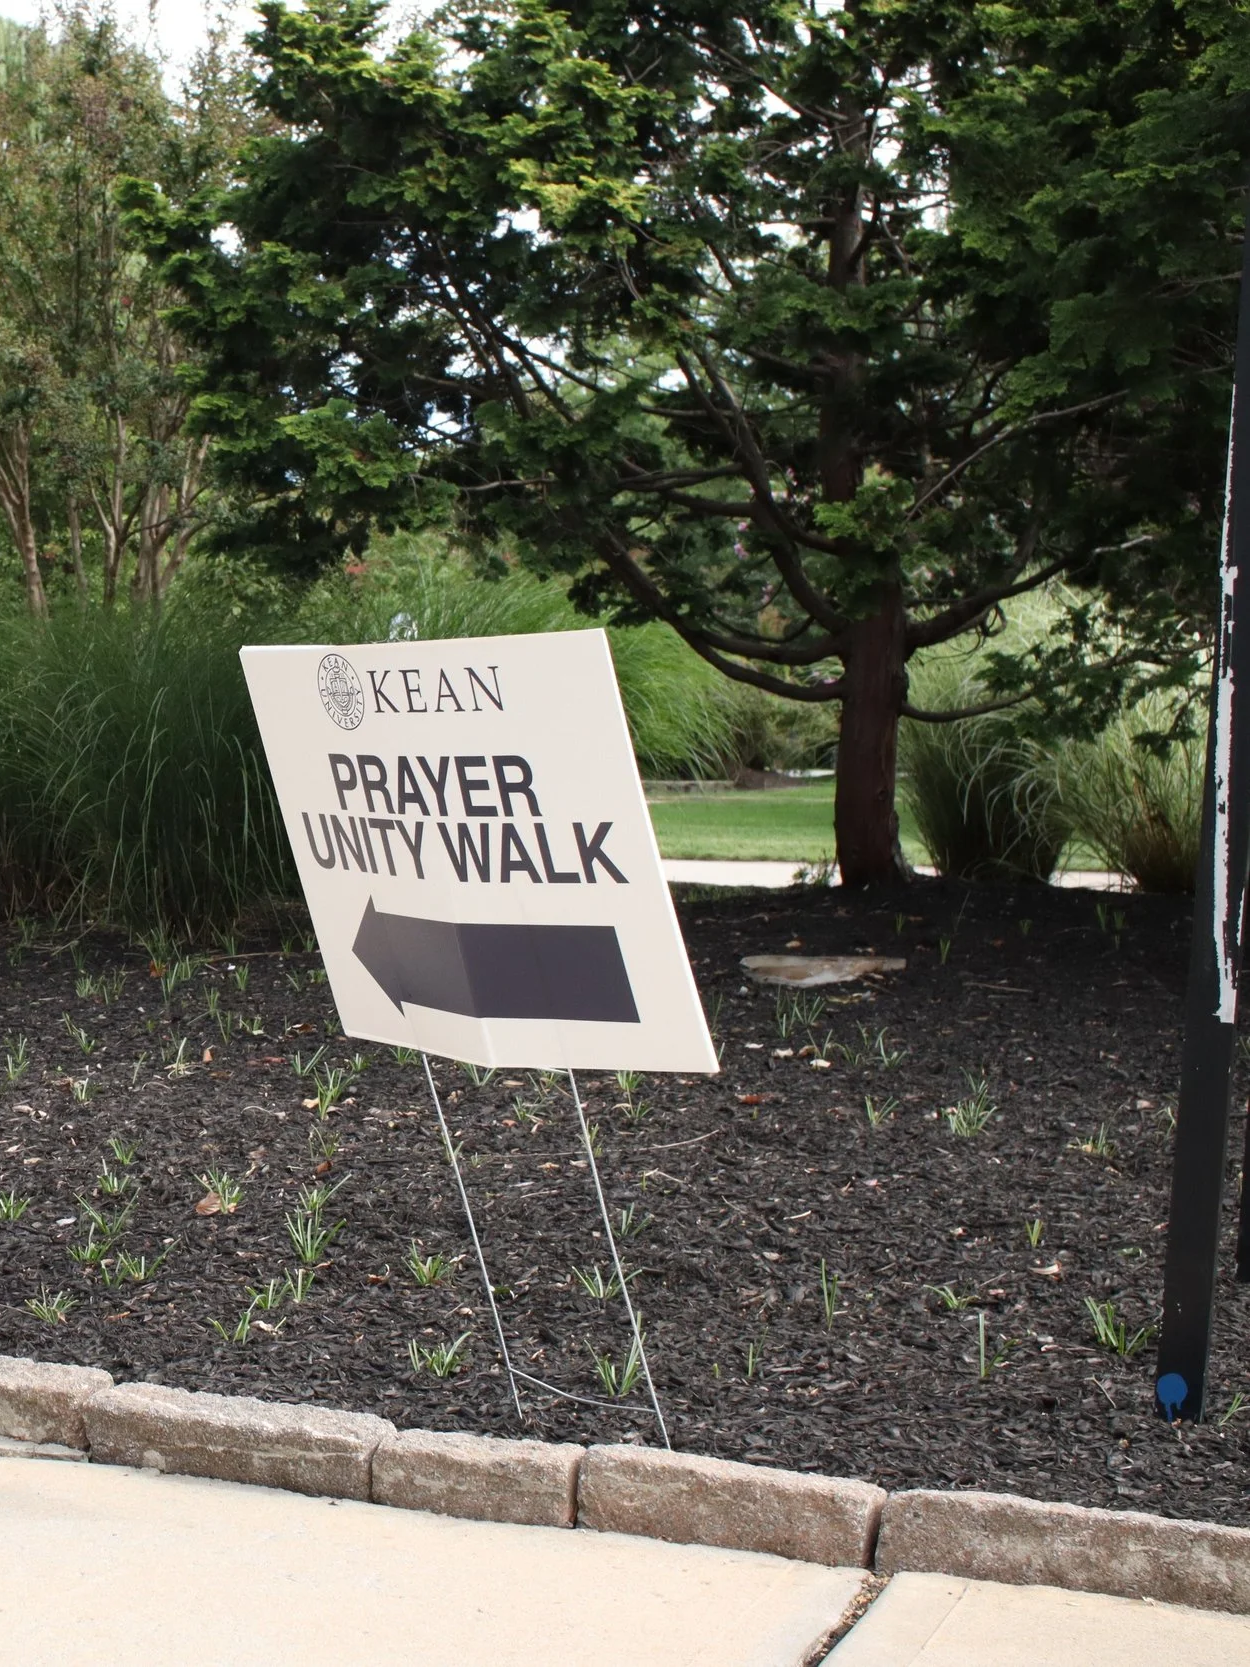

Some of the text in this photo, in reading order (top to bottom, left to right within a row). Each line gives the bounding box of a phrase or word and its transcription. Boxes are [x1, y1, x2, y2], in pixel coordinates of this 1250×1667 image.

[321, 657, 349, 673] KEAN
[366, 665, 504, 714] KEAN
[320, 688, 363, 728] UNIVERSITY
[327, 753, 543, 818] PRAYER
[301, 811, 631, 884] UNITY WALK
